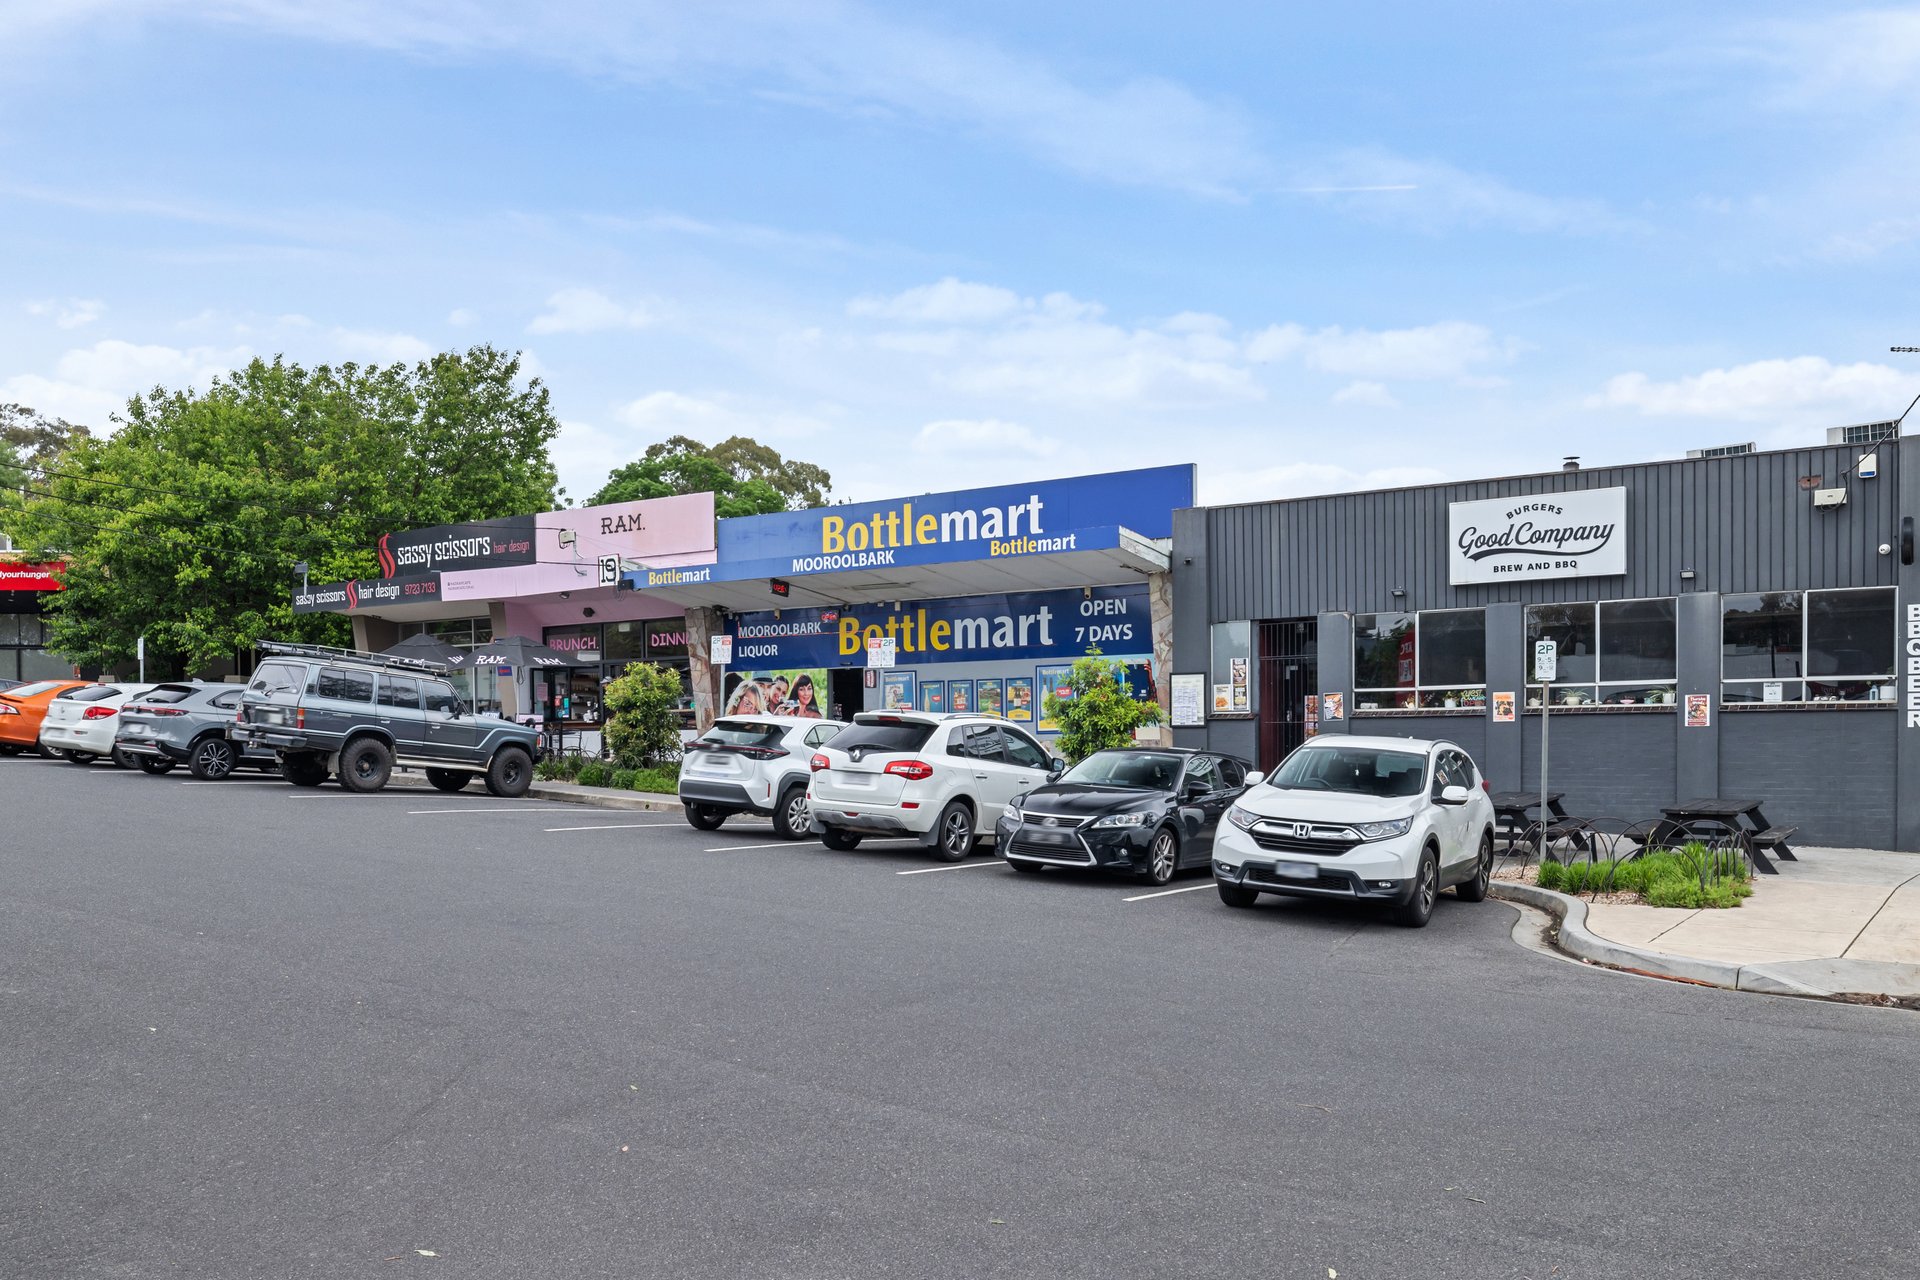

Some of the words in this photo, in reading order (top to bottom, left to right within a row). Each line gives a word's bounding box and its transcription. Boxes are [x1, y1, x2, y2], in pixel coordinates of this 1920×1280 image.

[1506, 503, 1563, 520] BURGERS
[601, 513, 645, 534] RAM.
[822, 495, 1043, 554] Bottlemart
[990, 533, 1076, 556] Bottlemart
[1458, 524, 1515, 557] Good
[1515, 521, 1614, 549] Company
[397, 543, 432, 567] sassy
[435, 535, 490, 560] scissors
[493, 541, 507, 554] hair
[509, 540, 530, 555] design
[792, 550, 895, 573] MOOROOLBARK
[1493, 564, 1523, 573] BREW
[1527, 562, 1550, 571] AND
[1555, 560, 1577, 569] BBQ
[648, 568, 710, 585] Bottlemart
[295, 594, 315, 607] sassy
[316, 590, 346, 603] scissors
[358, 584, 373, 599] hair
[375, 583, 400, 599] design
[404, 583, 420, 596] 9723
[421, 582, 436, 595] 7133
[1080, 598, 1127, 617] OPEN
[738, 621, 821, 638] MOOROOLBARK
[839, 606, 1053, 655] Bottlemart
[1075, 627, 1084, 643] 7
[1089, 623, 1133, 642] DAYS
[738, 645, 778, 658] LIQUOR
[1537, 644, 1554, 655] 2P
